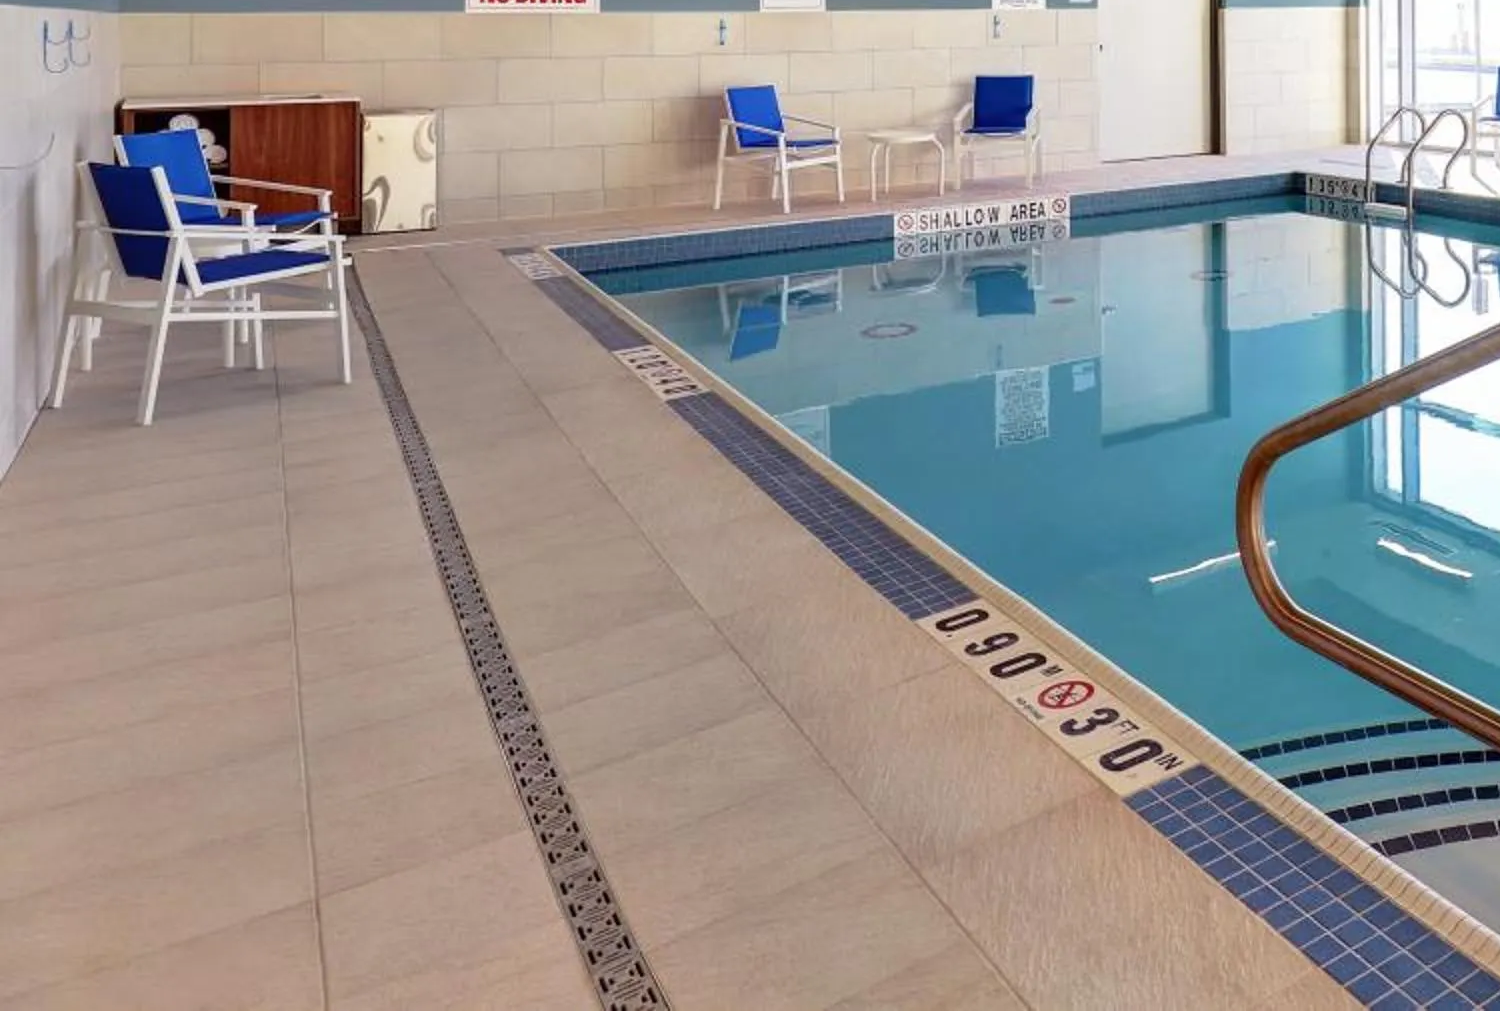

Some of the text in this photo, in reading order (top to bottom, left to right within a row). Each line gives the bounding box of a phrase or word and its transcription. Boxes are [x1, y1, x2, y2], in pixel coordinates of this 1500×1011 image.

[919, 201, 1047, 231] SHALLOW AREA
[1059, 707, 1121, 736] 3
[1111, 719, 1140, 735] FT
[1099, 738, 1164, 772] 0
[1153, 752, 1185, 771] IN
